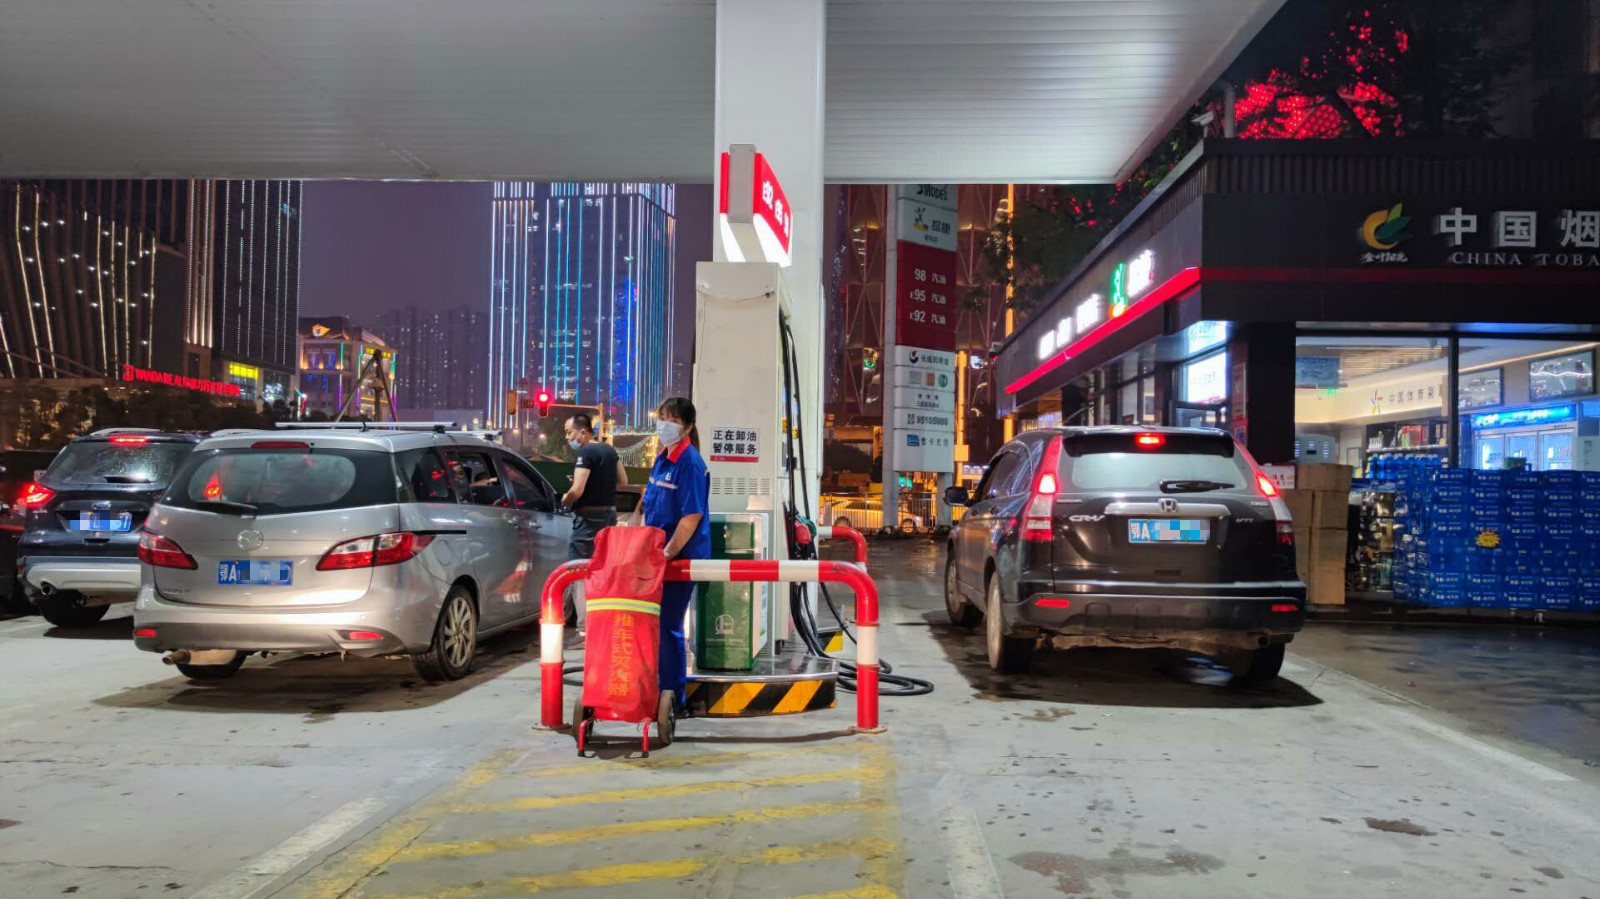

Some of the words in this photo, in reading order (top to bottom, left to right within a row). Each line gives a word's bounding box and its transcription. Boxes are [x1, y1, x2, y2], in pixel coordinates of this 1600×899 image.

[1452, 252, 1523, 265] CHINA
[914, 268, 926, 281] 98
[713, 429, 757, 442] 正在卸油
[713, 442, 757, 455] 暂停服务
[609, 613, 635, 696] 推车式灭火器
